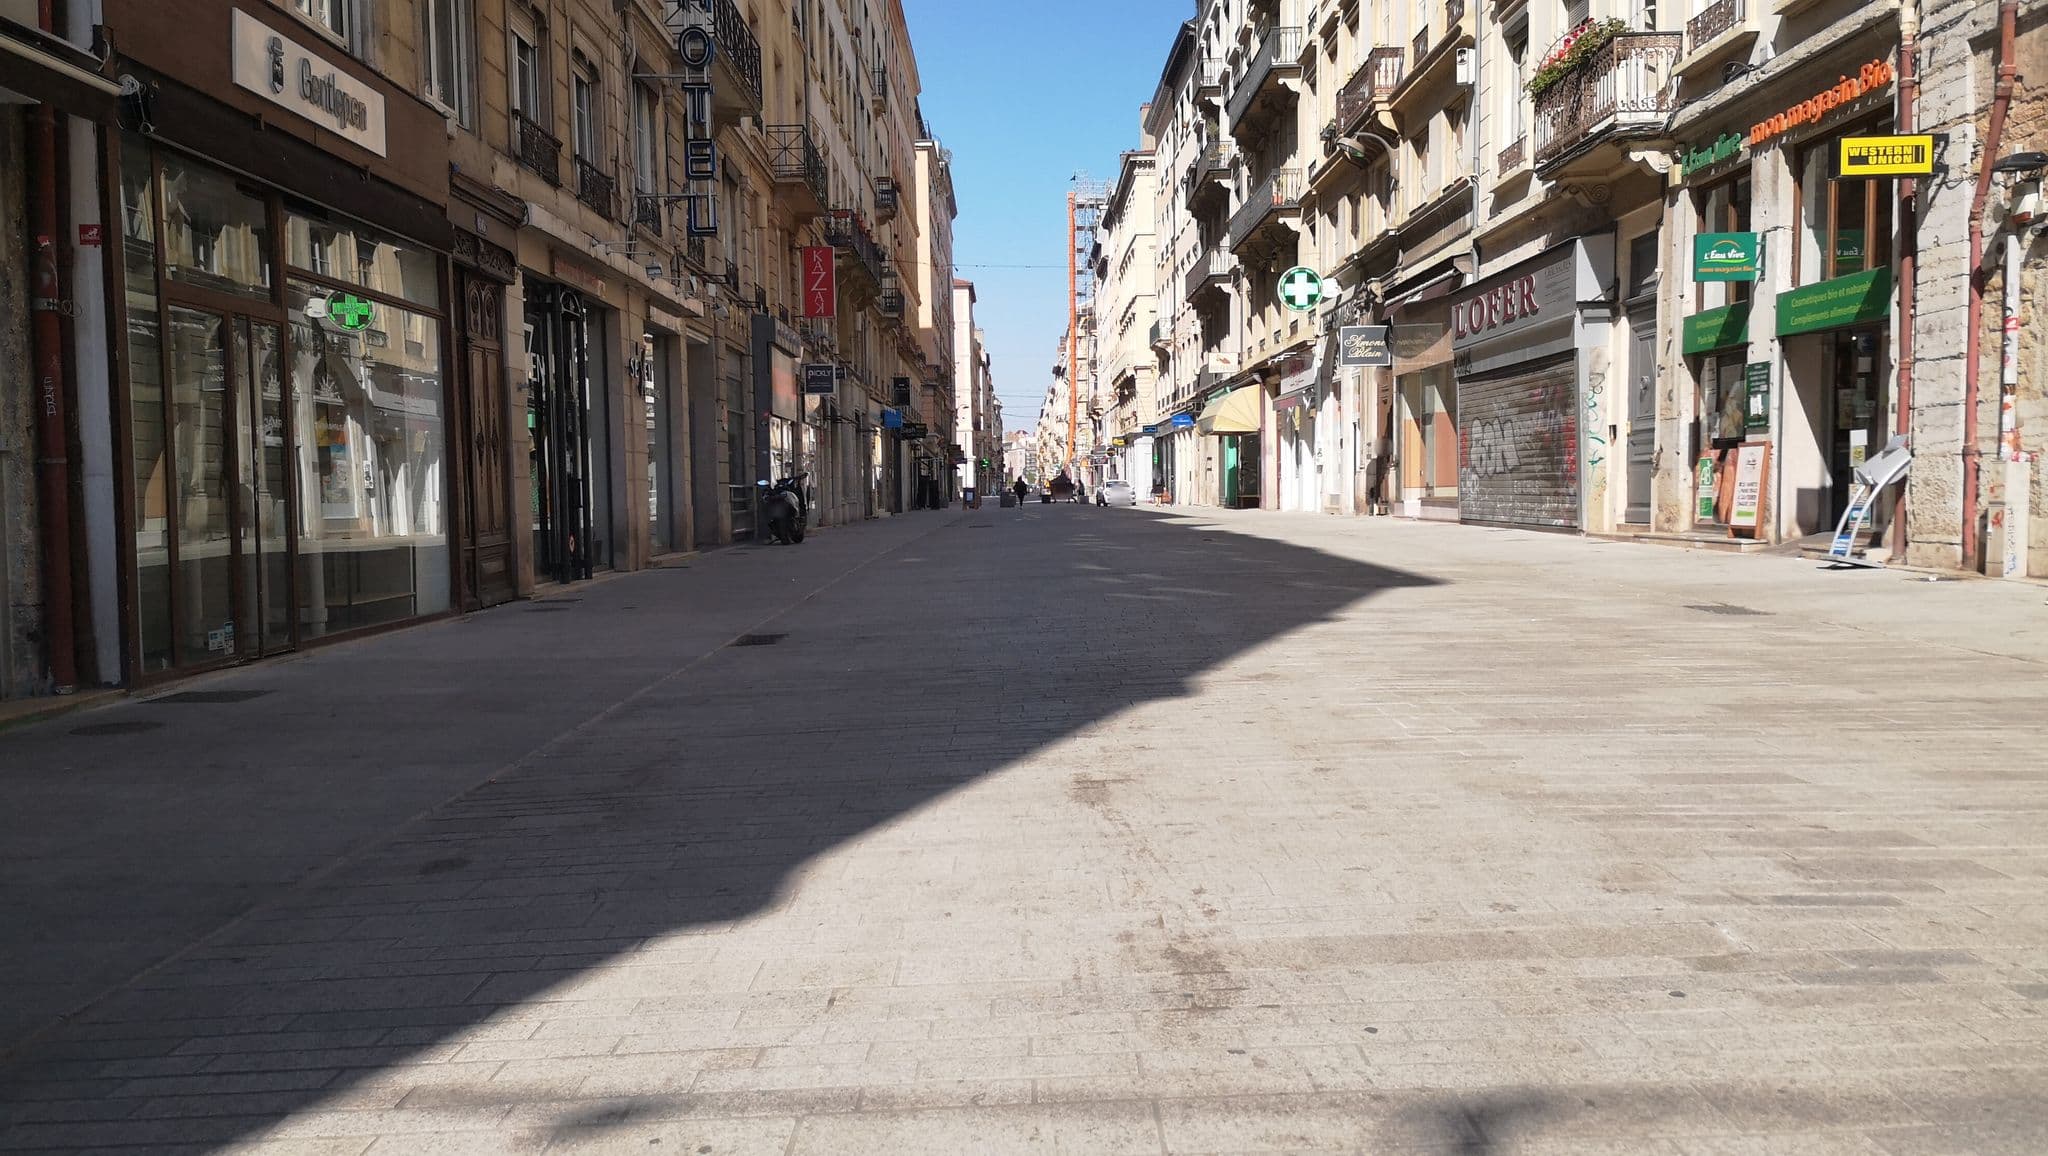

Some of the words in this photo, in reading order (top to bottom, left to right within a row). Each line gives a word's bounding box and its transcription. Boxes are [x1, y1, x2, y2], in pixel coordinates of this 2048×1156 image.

[299, 57, 367, 131] Gentlepen
[1750, 112, 1788, 145] mon
[1787, 74, 1861, 124] magasin
[1860, 58, 1891, 95] Bio
[678, 0, 718, 238] OTEL
[1848, 145, 1913, 157] WESTERN
[1868, 155, 1913, 165] UNION
[1727, 248, 1746, 259] Vive
[1454, 273, 1541, 341] LOFER
[1343, 334, 1387, 348] Simone
[1347, 346, 1384, 358] Blain
